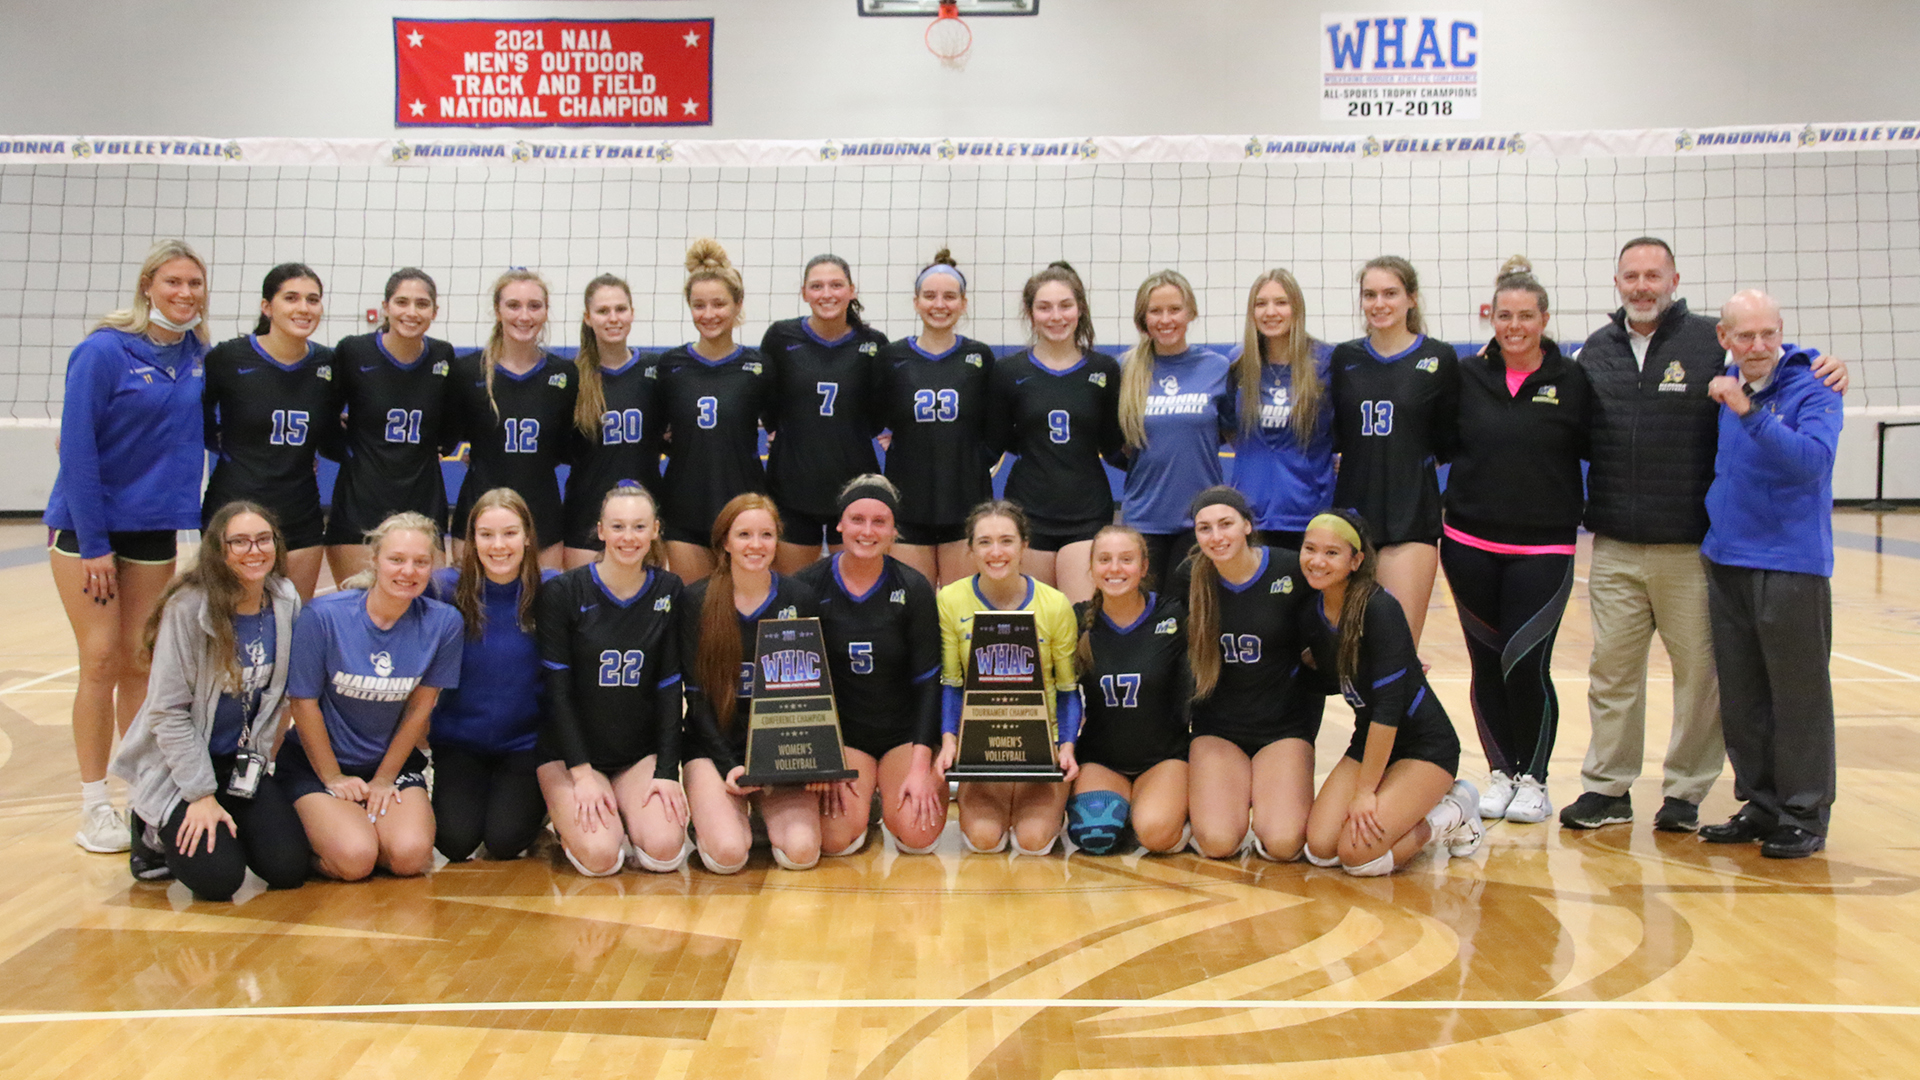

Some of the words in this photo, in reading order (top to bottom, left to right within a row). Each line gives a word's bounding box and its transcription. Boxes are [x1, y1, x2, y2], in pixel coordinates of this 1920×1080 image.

[495, 29, 545, 50] 2021
[561, 29, 612, 50] NAIA
[1326, 17, 1477, 69] WHAC
[464, 52, 529, 72] MEN'S
[541, 51, 644, 72] OUTDOOR
[452, 74, 524, 95] TRACK
[537, 74, 580, 95] AND
[593, 74, 656, 94] FIELD
[1324, 88, 1379, 99] ALL-SPORTS
[1382, 88, 1417, 98] TROPHY
[1421, 87, 1477, 97] CHAMPIONS
[439, 96, 547, 117] NATIONAL
[558, 96, 668, 117] CHAMPION
[1348, 101, 1453, 117] 2017-2018
[0, 141, 65, 154] DONNA
[93, 141, 223, 156] VOLLEYBALL
[1265, 140, 1356, 153] MADONNA
[1382, 137, 1508, 153] VOLLEYBALL
[1696, 131, 1791, 145] MADONNA
[414, 144, 506, 157] MADONNA
[532, 144, 656, 159] VOLLEYBALL
[841, 143, 931, 156] MADONNA
[957, 142, 1080, 156] VOLLEYBALL
[817, 382, 839, 417] 7
[914, 388, 959, 423] 23
[1146, 393, 1208, 405] ADONNA
[697, 396, 718, 430] 3
[1361, 400, 1394, 436] 13
[270, 410, 310, 446] 15
[385, 408, 423, 444] 21
[504, 418, 540, 453] 12
[602, 409, 643, 445] 20
[1048, 410, 1070, 444] 9
[848, 642, 874, 674] 5
[1219, 633, 1262, 663] 19
[599, 649, 644, 687] 22
[761, 650, 821, 682] WHAC
[975, 643, 1034, 675] WHAC
[1100, 673, 1142, 708] 17
[761, 715, 796, 726] CONFERENCE
[797, 713, 826, 723] CHAMPION
[972, 708, 1008, 717] TOURNAMENT
[1009, 708, 1038, 717] CHAMPION
[778, 743, 813, 756] WOMEN'S
[988, 736, 1023, 748] WOMEN'S
[775, 758, 818, 771] VOLLEYBALL
[984, 750, 1027, 762] VOLLEYBALL
